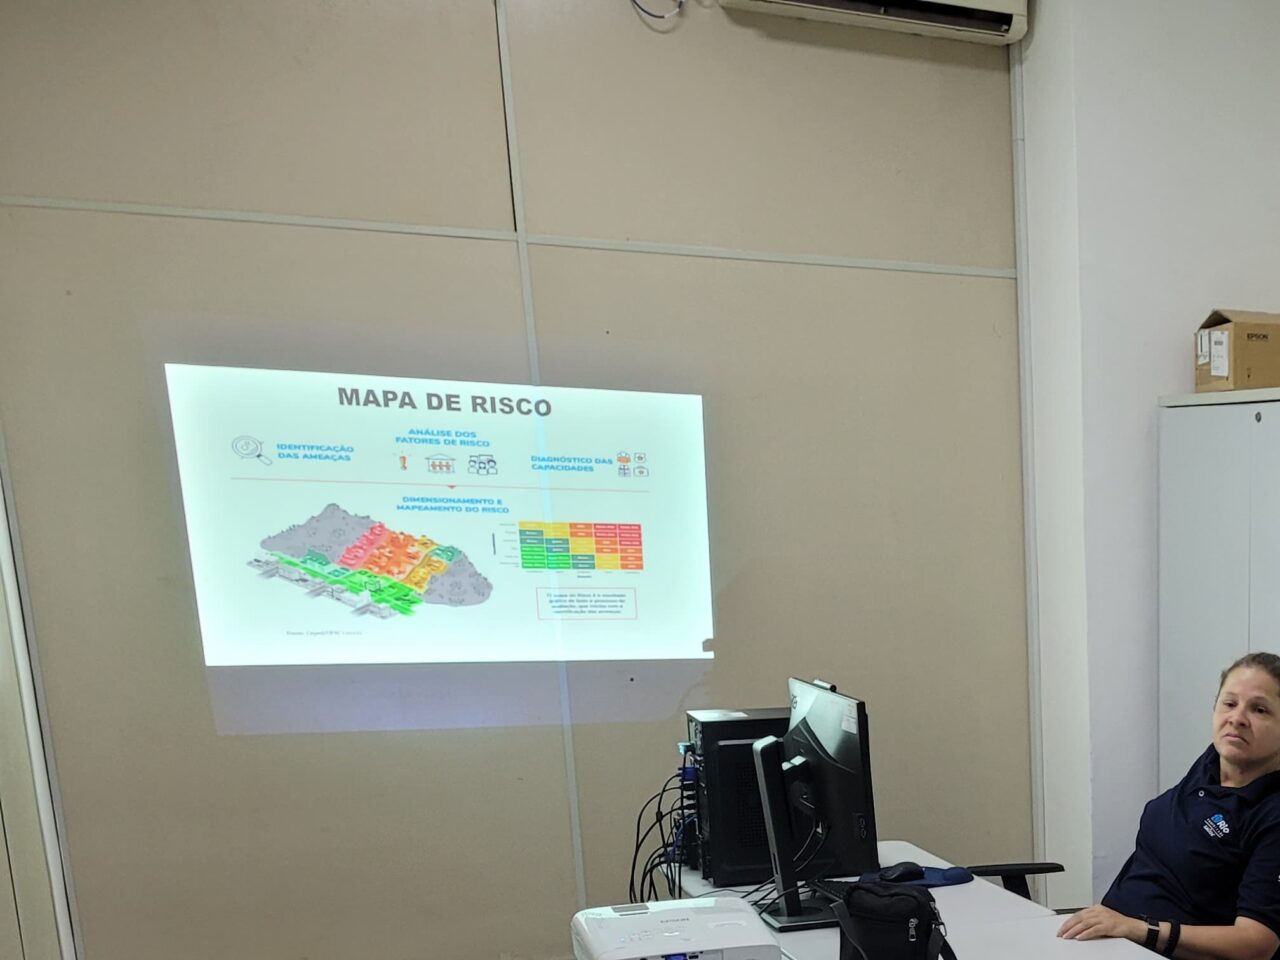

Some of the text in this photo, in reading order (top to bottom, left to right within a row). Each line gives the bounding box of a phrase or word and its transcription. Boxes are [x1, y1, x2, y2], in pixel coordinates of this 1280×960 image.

[1246, 333, 1269, 341] EPSON
[338, 387, 552, 417] MAPA DE RISCO
[408, 428, 477, 439] ANÁLISE DOS
[395, 436, 490, 448] FATORES DE RISCO
[276, 443, 354, 454] IDENTIFICAÇÃO
[278, 452, 351, 462] DAS AMEAÇAS
[530, 454, 614, 465] DIAGNÓSTICO DAS
[531, 464, 594, 473] CAPACIDADES
[402, 496, 503, 506] DIMENSIONAMENTO E
[396, 504, 510, 514] MAPEAMENTO DO RISCO
